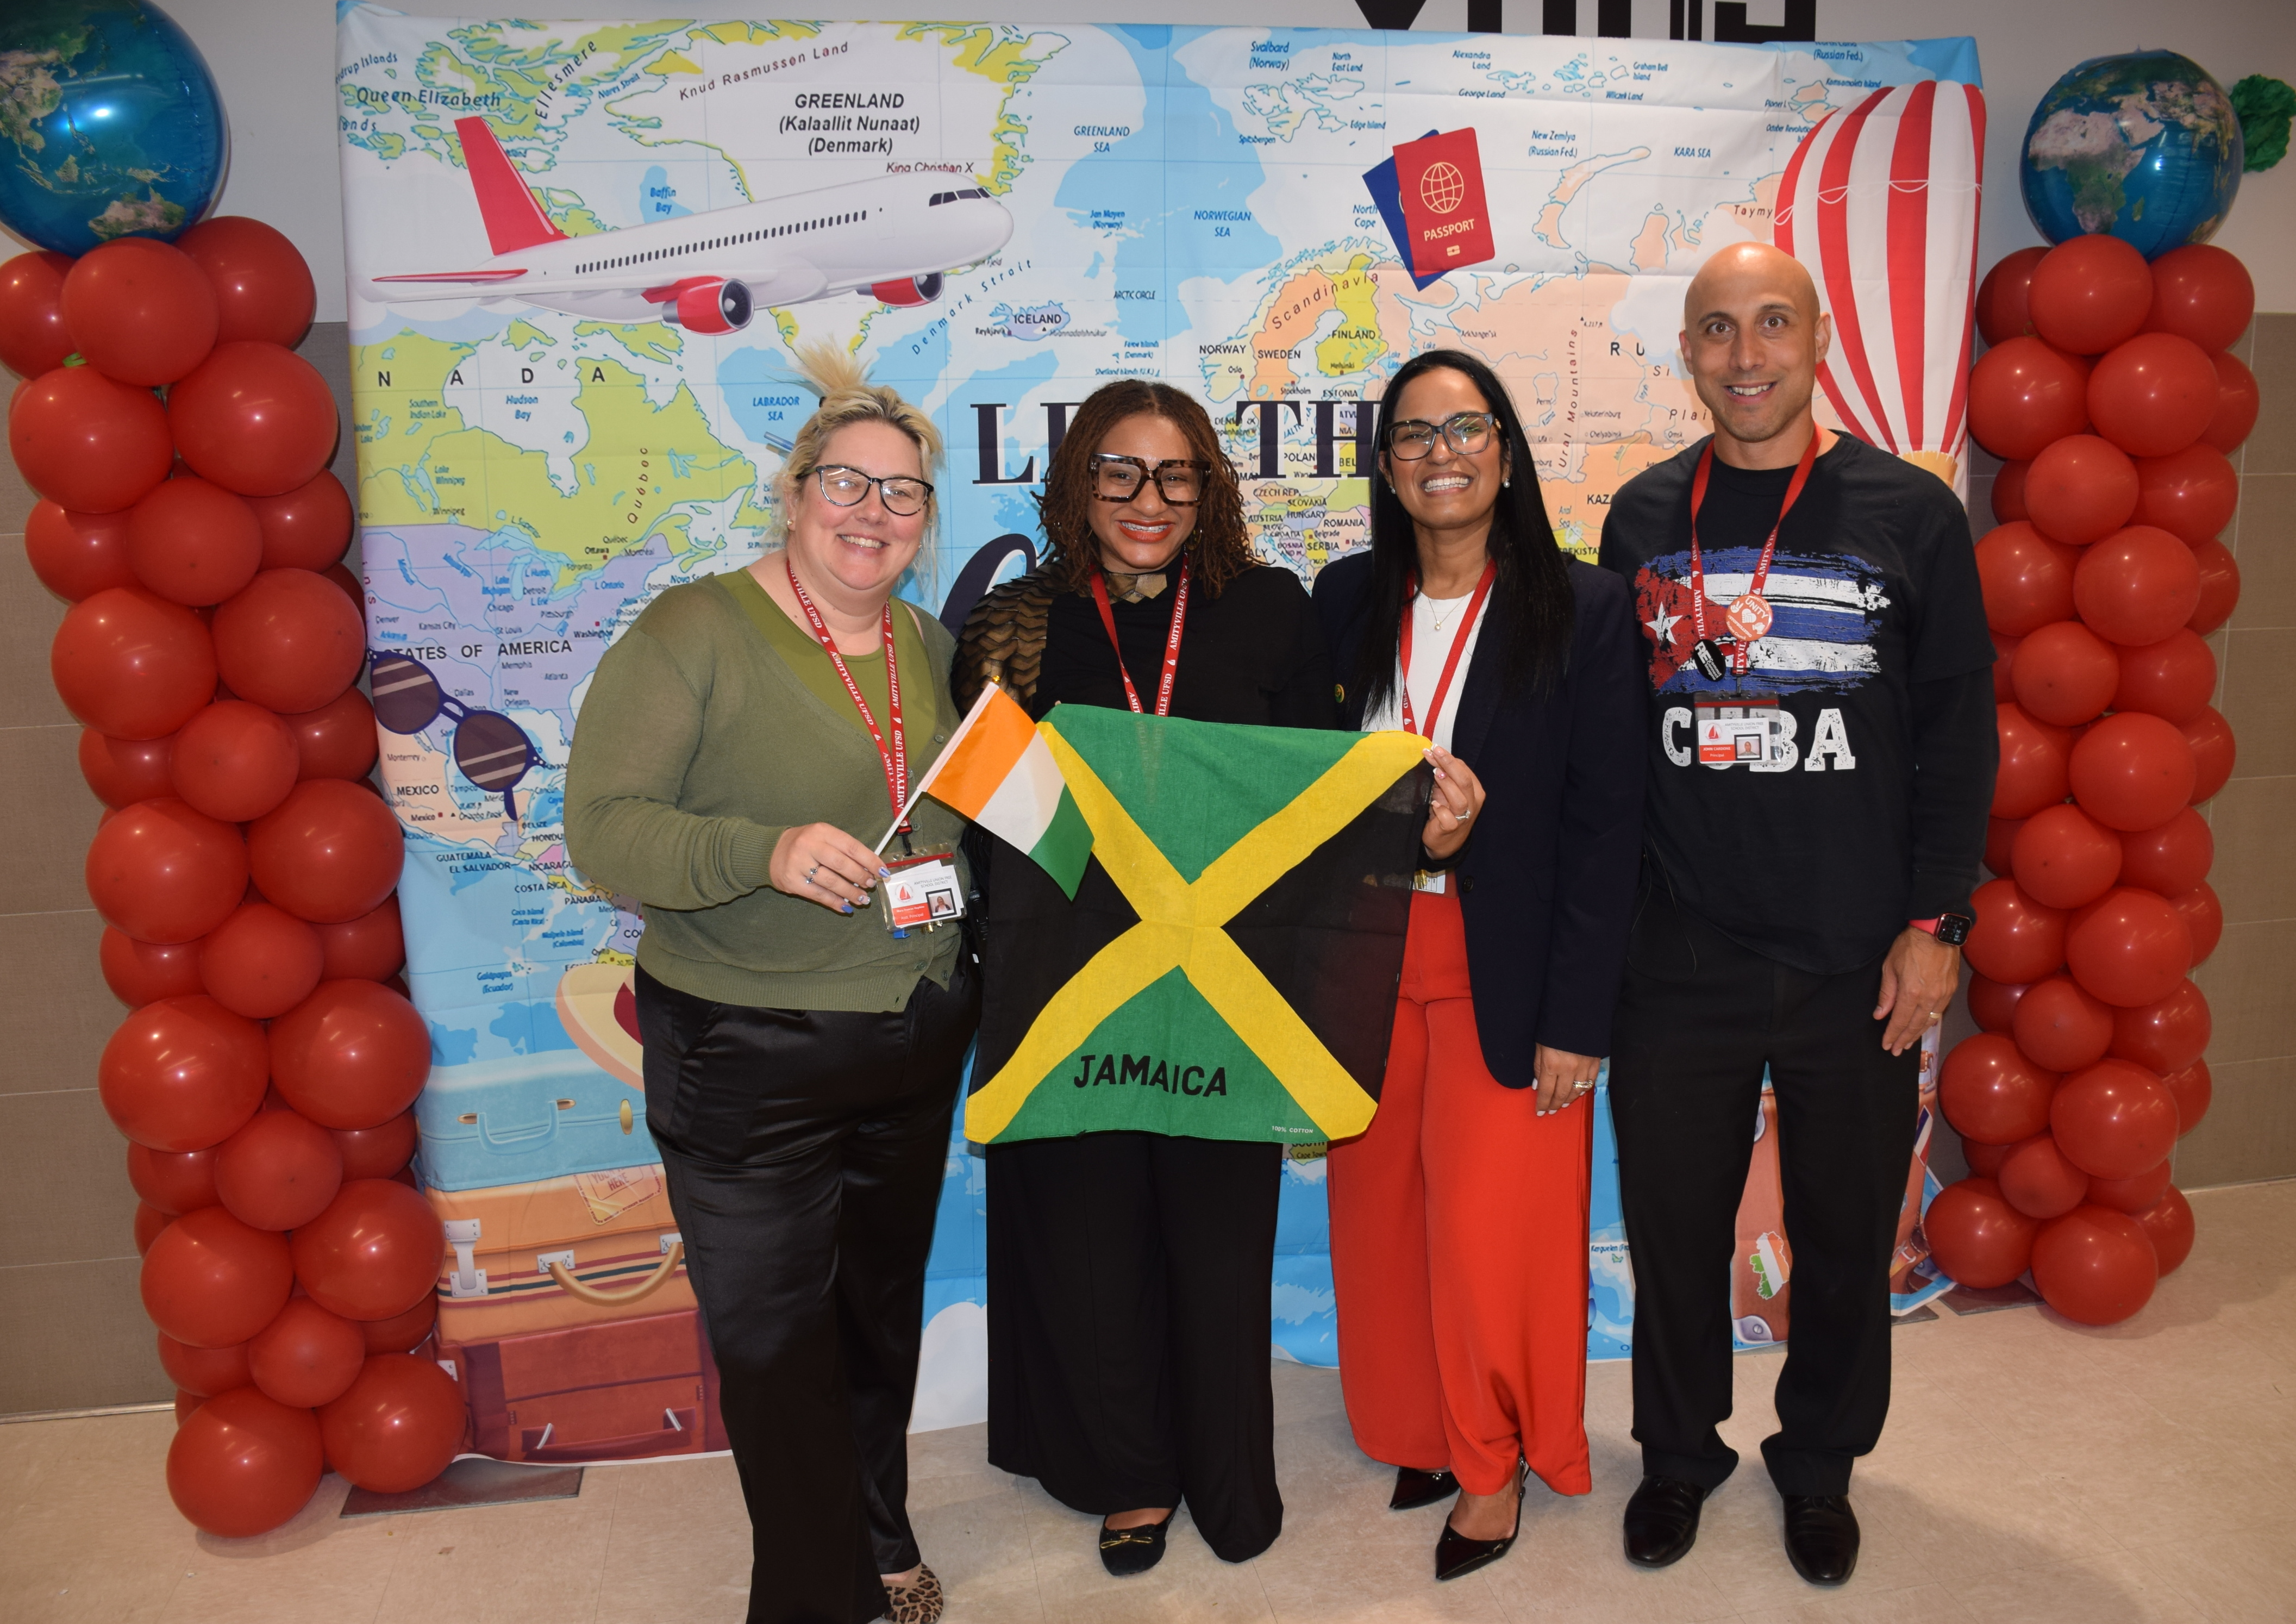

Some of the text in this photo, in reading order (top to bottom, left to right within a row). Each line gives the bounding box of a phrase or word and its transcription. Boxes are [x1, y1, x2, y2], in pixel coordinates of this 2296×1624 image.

[1250, 41, 1289, 53] Svalbard
[1249, 58, 1290, 71] (Norway)
[679, 79, 715, 101] Knud
[814, 41, 849, 59] Land
[535, 40, 597, 120] Ellesmere
[357, 87, 501, 107] Queen Elizabeth
[795, 93, 905, 109] GREENLAND
[779, 115, 920, 134] (Kalaallit Nunaat)
[1074, 126, 1130, 138] GREENLAND
[1532, 130, 1548, 141] New
[808, 137, 893, 155] (Denmark)
[1093, 142, 1110, 153] SEA
[1529, 146, 1578, 158] (Russian Fed.)
[1674, 147, 1711, 159] KARA SEA
[965, 163, 974, 173] X
[655, 202, 672, 214] Bay
[1734, 205, 1773, 218] Taymy
[1194, 210, 1252, 221] NORWEGIAN
[1354, 217, 1376, 228] Cape
[1215, 227, 1230, 238] SEA
[1423, 218, 1475, 241] PASSPORT
[1272, 273, 1378, 329] Scandinavia
[912, 293, 973, 355] Denmark
[1014, 314, 1062, 324] ICELAND
[1332, 330, 1376, 339] FINLAND
[1199, 345, 1246, 354] NORWAY
[1258, 349, 1300, 359] SWEDEN
[1323, 389, 1358, 397] ESTONIA
[1559, 329, 1578, 468] Ural Mountains
[506, 395, 538, 404] Hudson
[753, 397, 800, 407] LABRADOR
[515, 409, 531, 421] Bay
[768, 411, 783, 421] SEA
[1248, 514, 1284, 523] AUSTRIA
[1287, 510, 1327, 519] HUNGARY
[1307, 542, 1340, 551] SERBIA
[671, 575, 690, 584] Nova
[1745, 597, 1769, 619] UNITY
[807, 607, 822, 628] UFSD
[1169, 600, 1184, 650] AMITYVILLE
[461, 645, 483, 659] OF
[498, 640, 573, 656] AMERICA
[1709, 658, 1722, 677] Commit
[887, 644, 899, 709] AMITYVILLE UFSD
[830, 651, 874, 726] AMITYVILLE UFSD
[1162, 673, 1172, 695] UFSD
[894, 730, 905, 809] AMITYVILLE UFSD
[396, 785, 439, 795] MEXICO
[436, 852, 492, 862] GUATEMALA
[449, 863, 511, 873] EL SALVADOR
[514, 884, 545, 894] COSTA
[1074, 1054, 1227, 1097] JAMAICA
[607, 1172, 629, 1191] HERE
